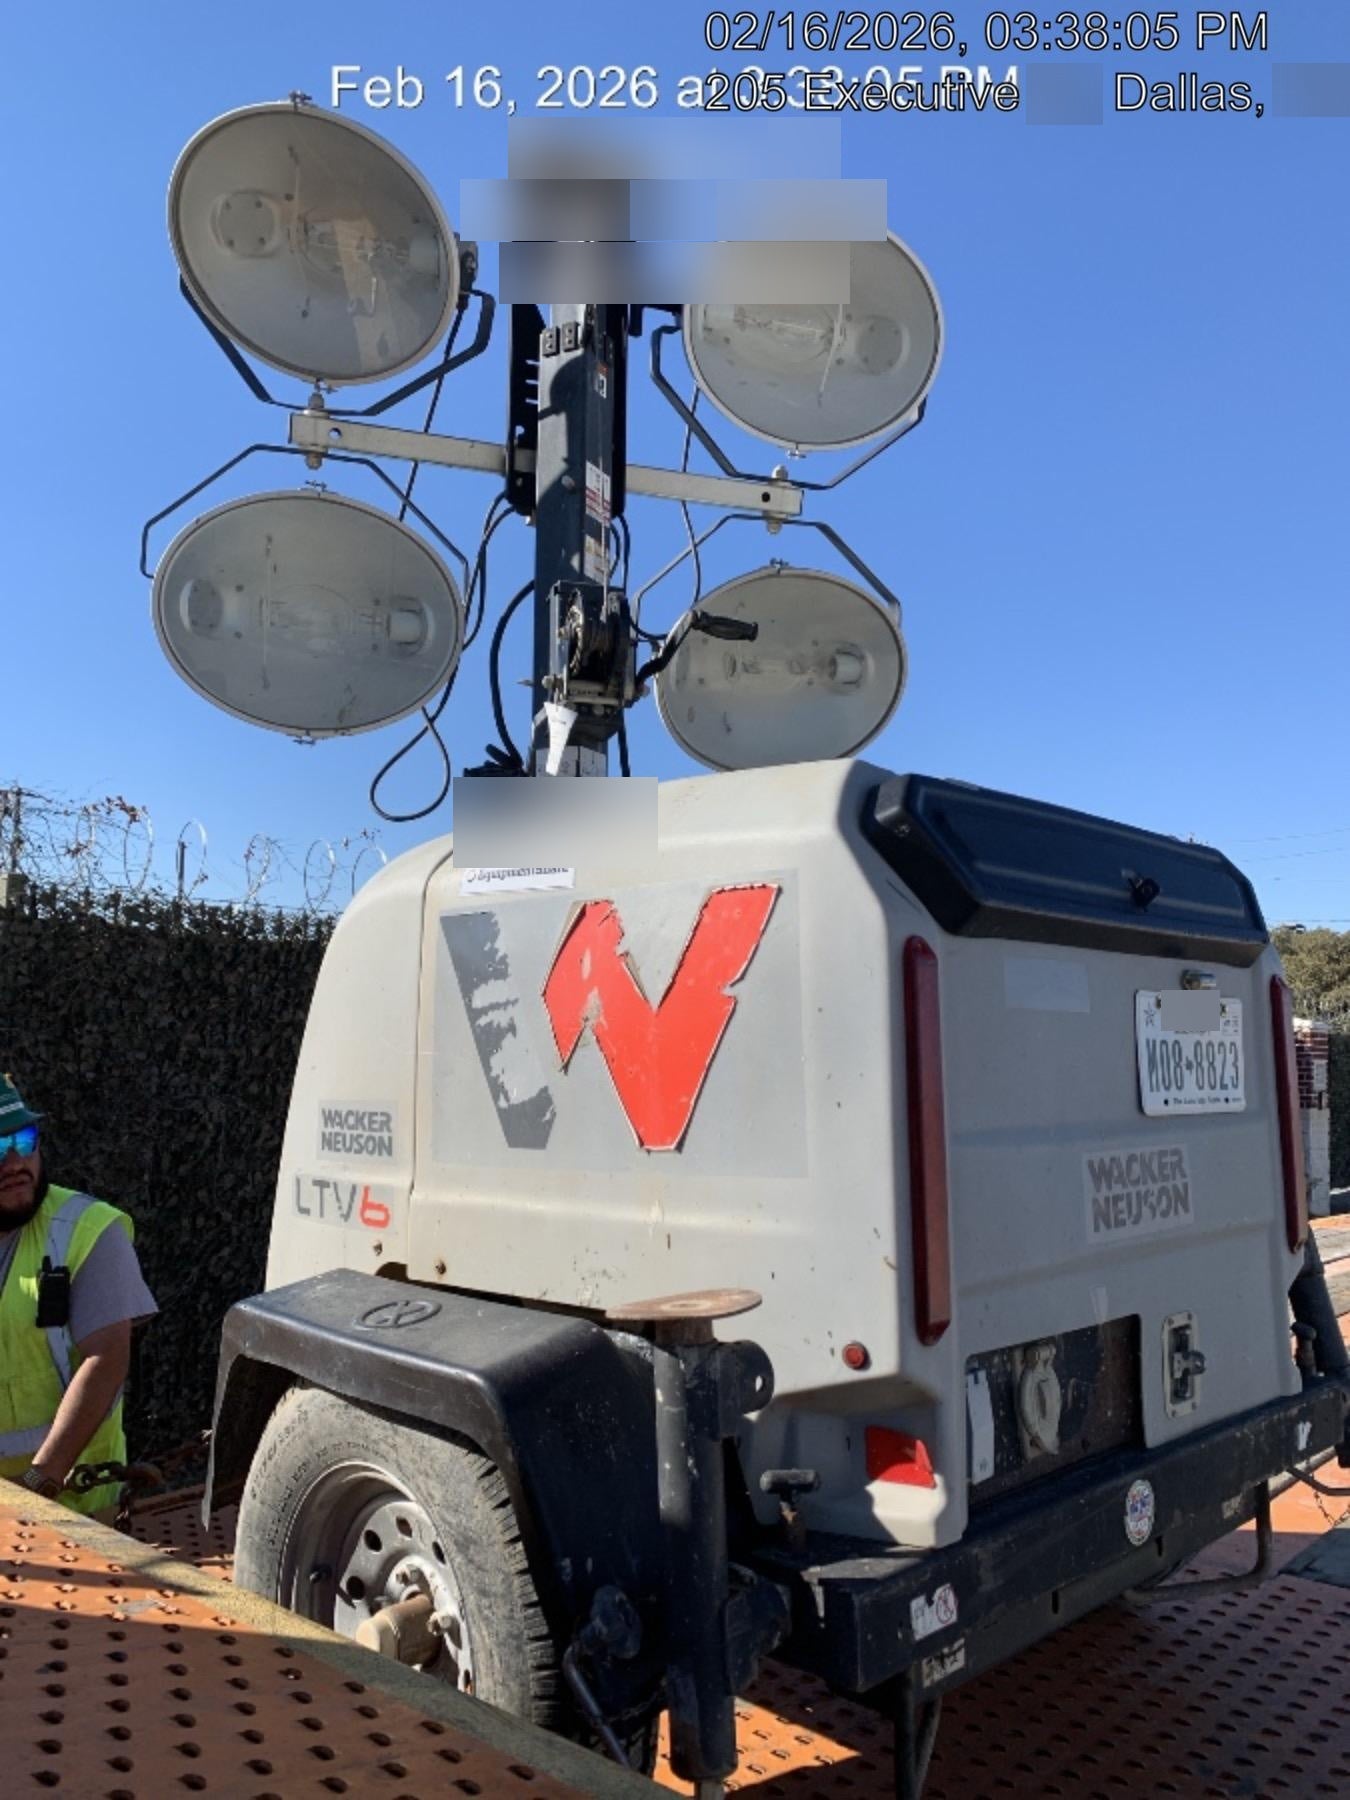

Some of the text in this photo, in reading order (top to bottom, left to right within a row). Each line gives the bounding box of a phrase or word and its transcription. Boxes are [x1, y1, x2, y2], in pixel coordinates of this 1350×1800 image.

[321, 1108, 393, 1133] WACKER
[321, 1131, 394, 1157] NEUSON
[1087, 1147, 1188, 1193] WACKER
[1092, 1181, 1190, 1233] NEUSON
